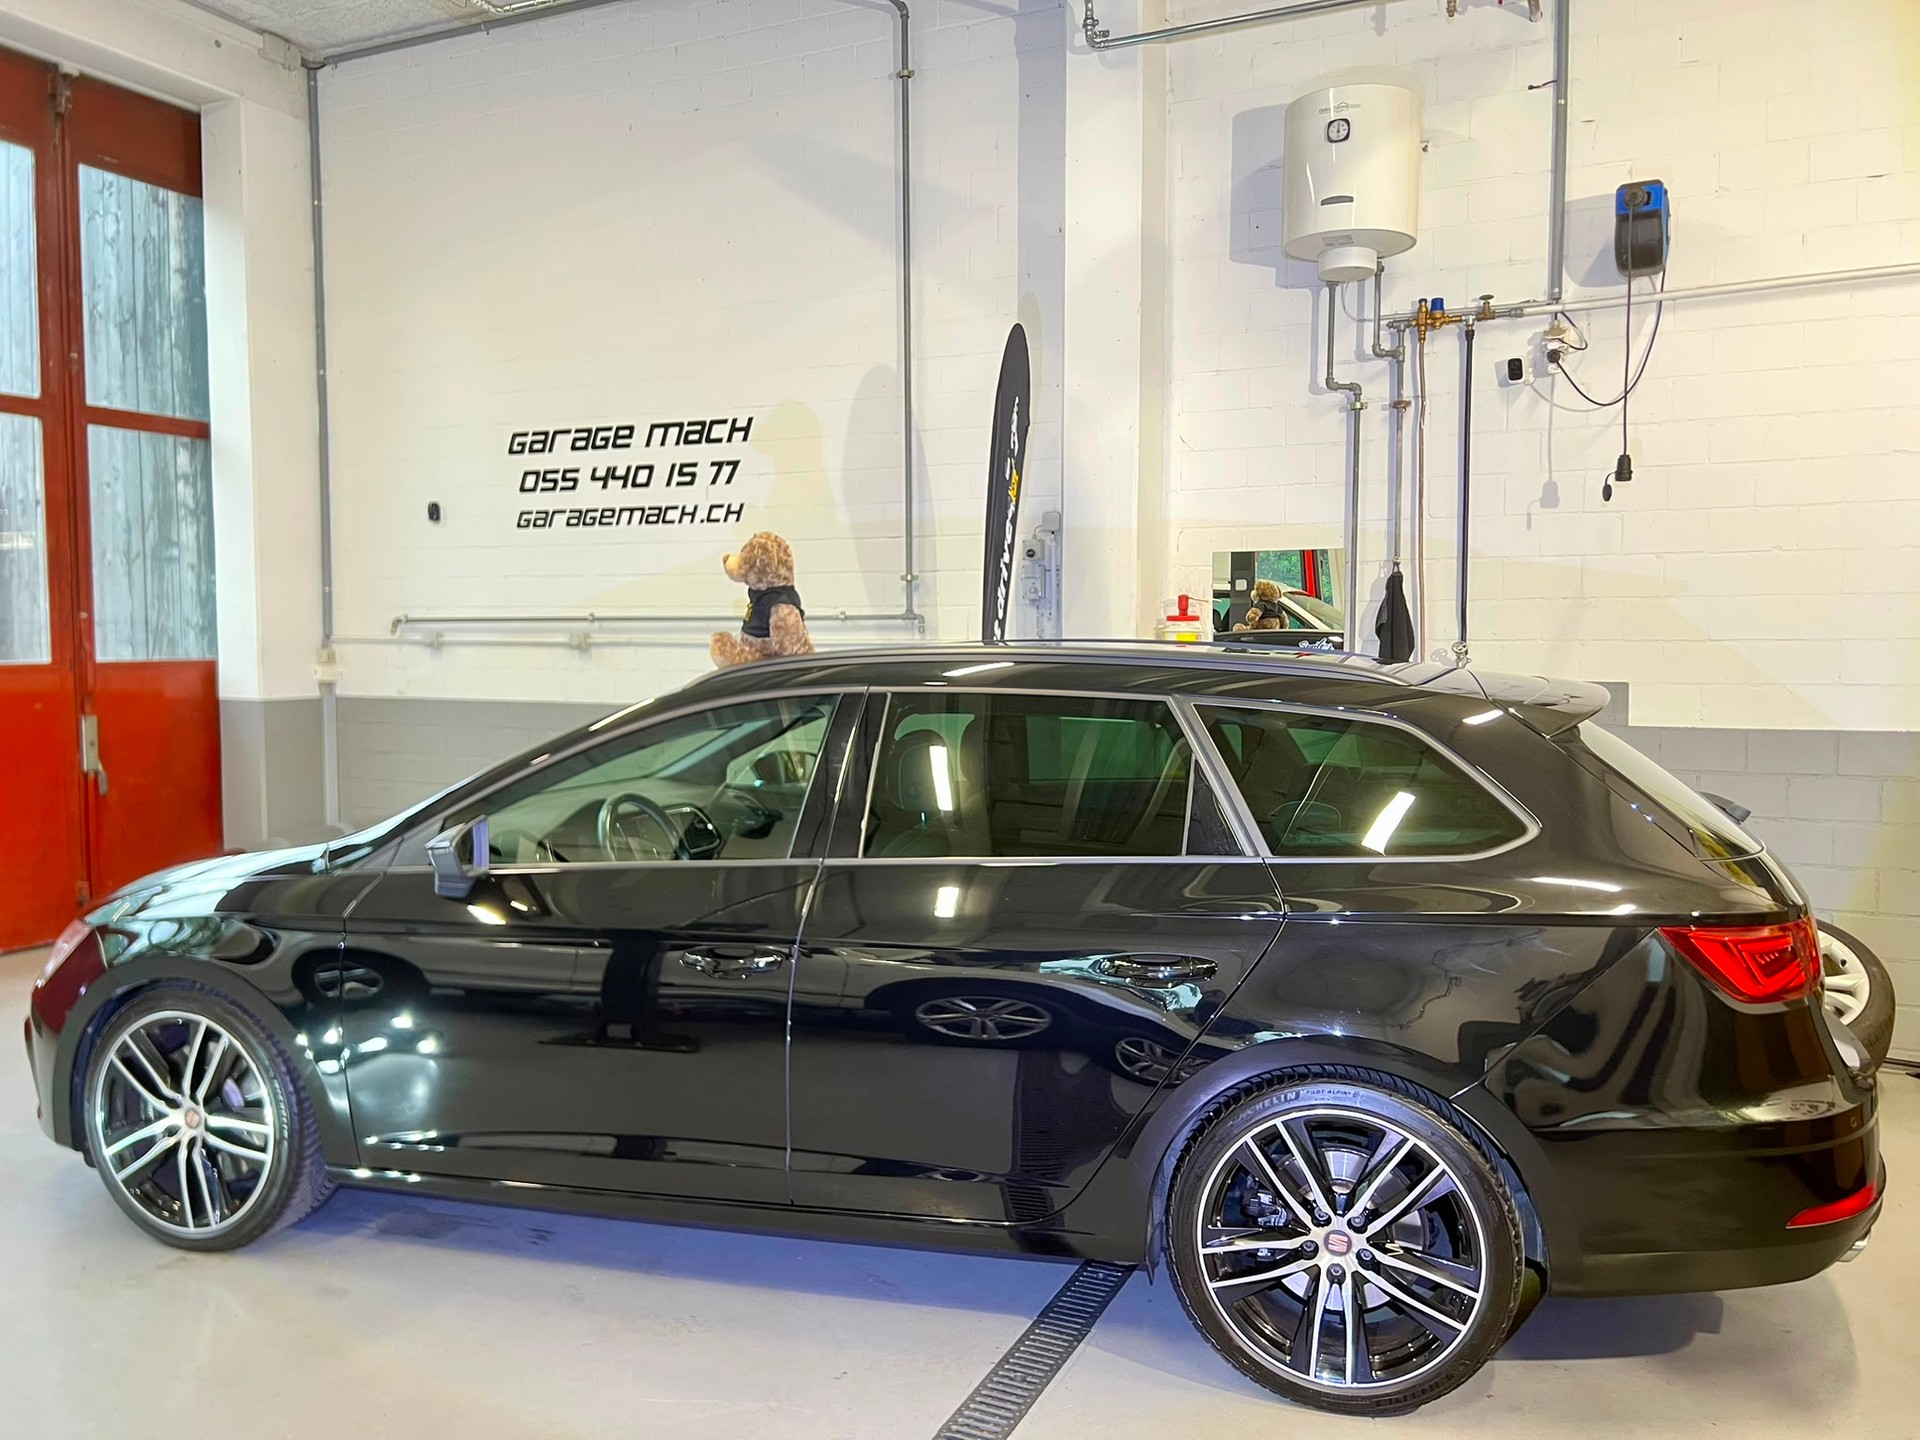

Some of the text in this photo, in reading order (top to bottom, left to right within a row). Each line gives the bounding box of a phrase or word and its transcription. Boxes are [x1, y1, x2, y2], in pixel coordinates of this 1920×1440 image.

[519, 459, 741, 493] 055 440 15 77
